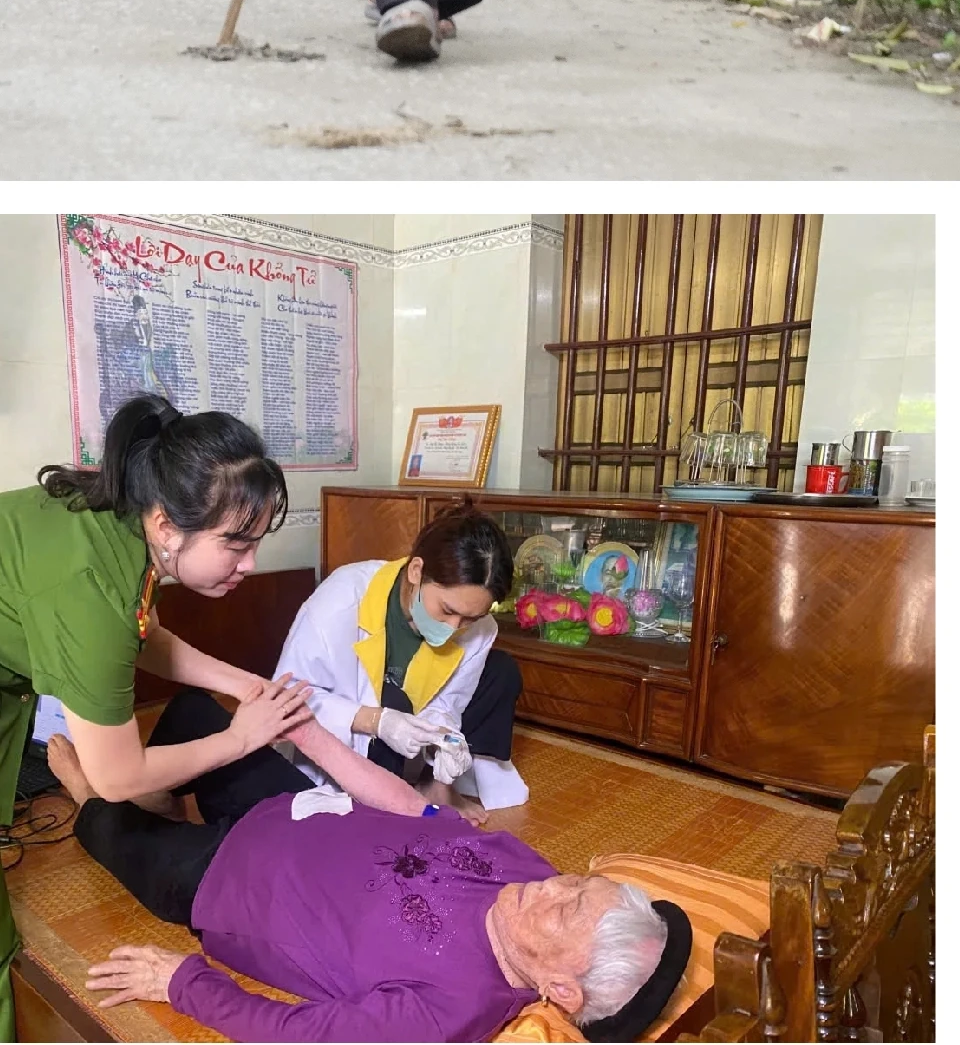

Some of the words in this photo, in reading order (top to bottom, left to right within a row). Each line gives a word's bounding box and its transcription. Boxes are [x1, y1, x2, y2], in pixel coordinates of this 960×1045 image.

[160, 240, 202, 283] Dạy
[203, 250, 245, 275] Của
[249, 258, 296, 300] Khổng
[295, 266, 317, 287] Tử
